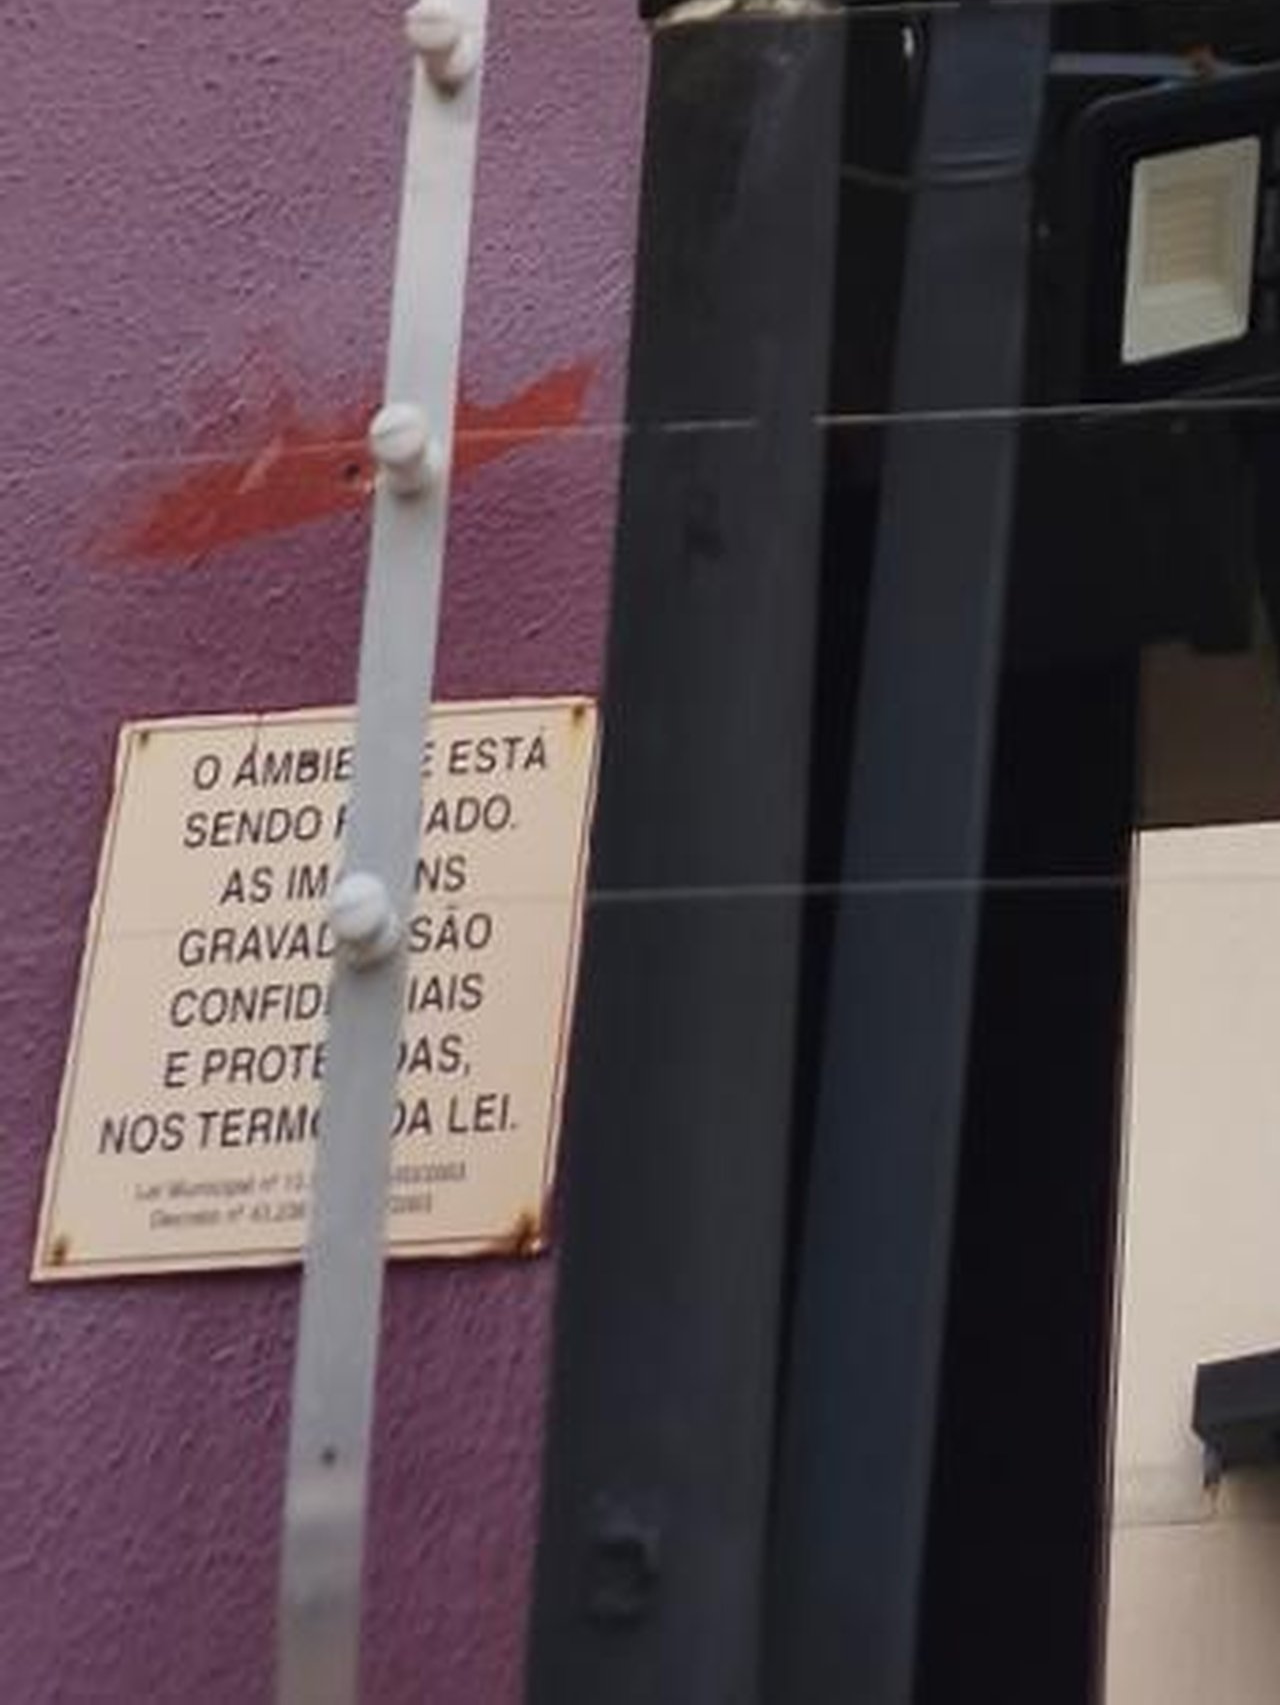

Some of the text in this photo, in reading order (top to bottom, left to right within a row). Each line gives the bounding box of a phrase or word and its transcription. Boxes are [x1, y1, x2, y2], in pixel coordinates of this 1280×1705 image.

[193, 754, 222, 791] O
[448, 727, 548, 776] ESTÁ
[183, 805, 323, 849] SENDO
[219, 855, 469, 905] AS IMNS
[408, 904, 494, 953] SÃO
[169, 973, 486, 1029] CONFIDIAIS
[163, 1050, 192, 1088] E
[98, 1114, 186, 1155] NOS
[446, 1093, 518, 1134] LEI.
